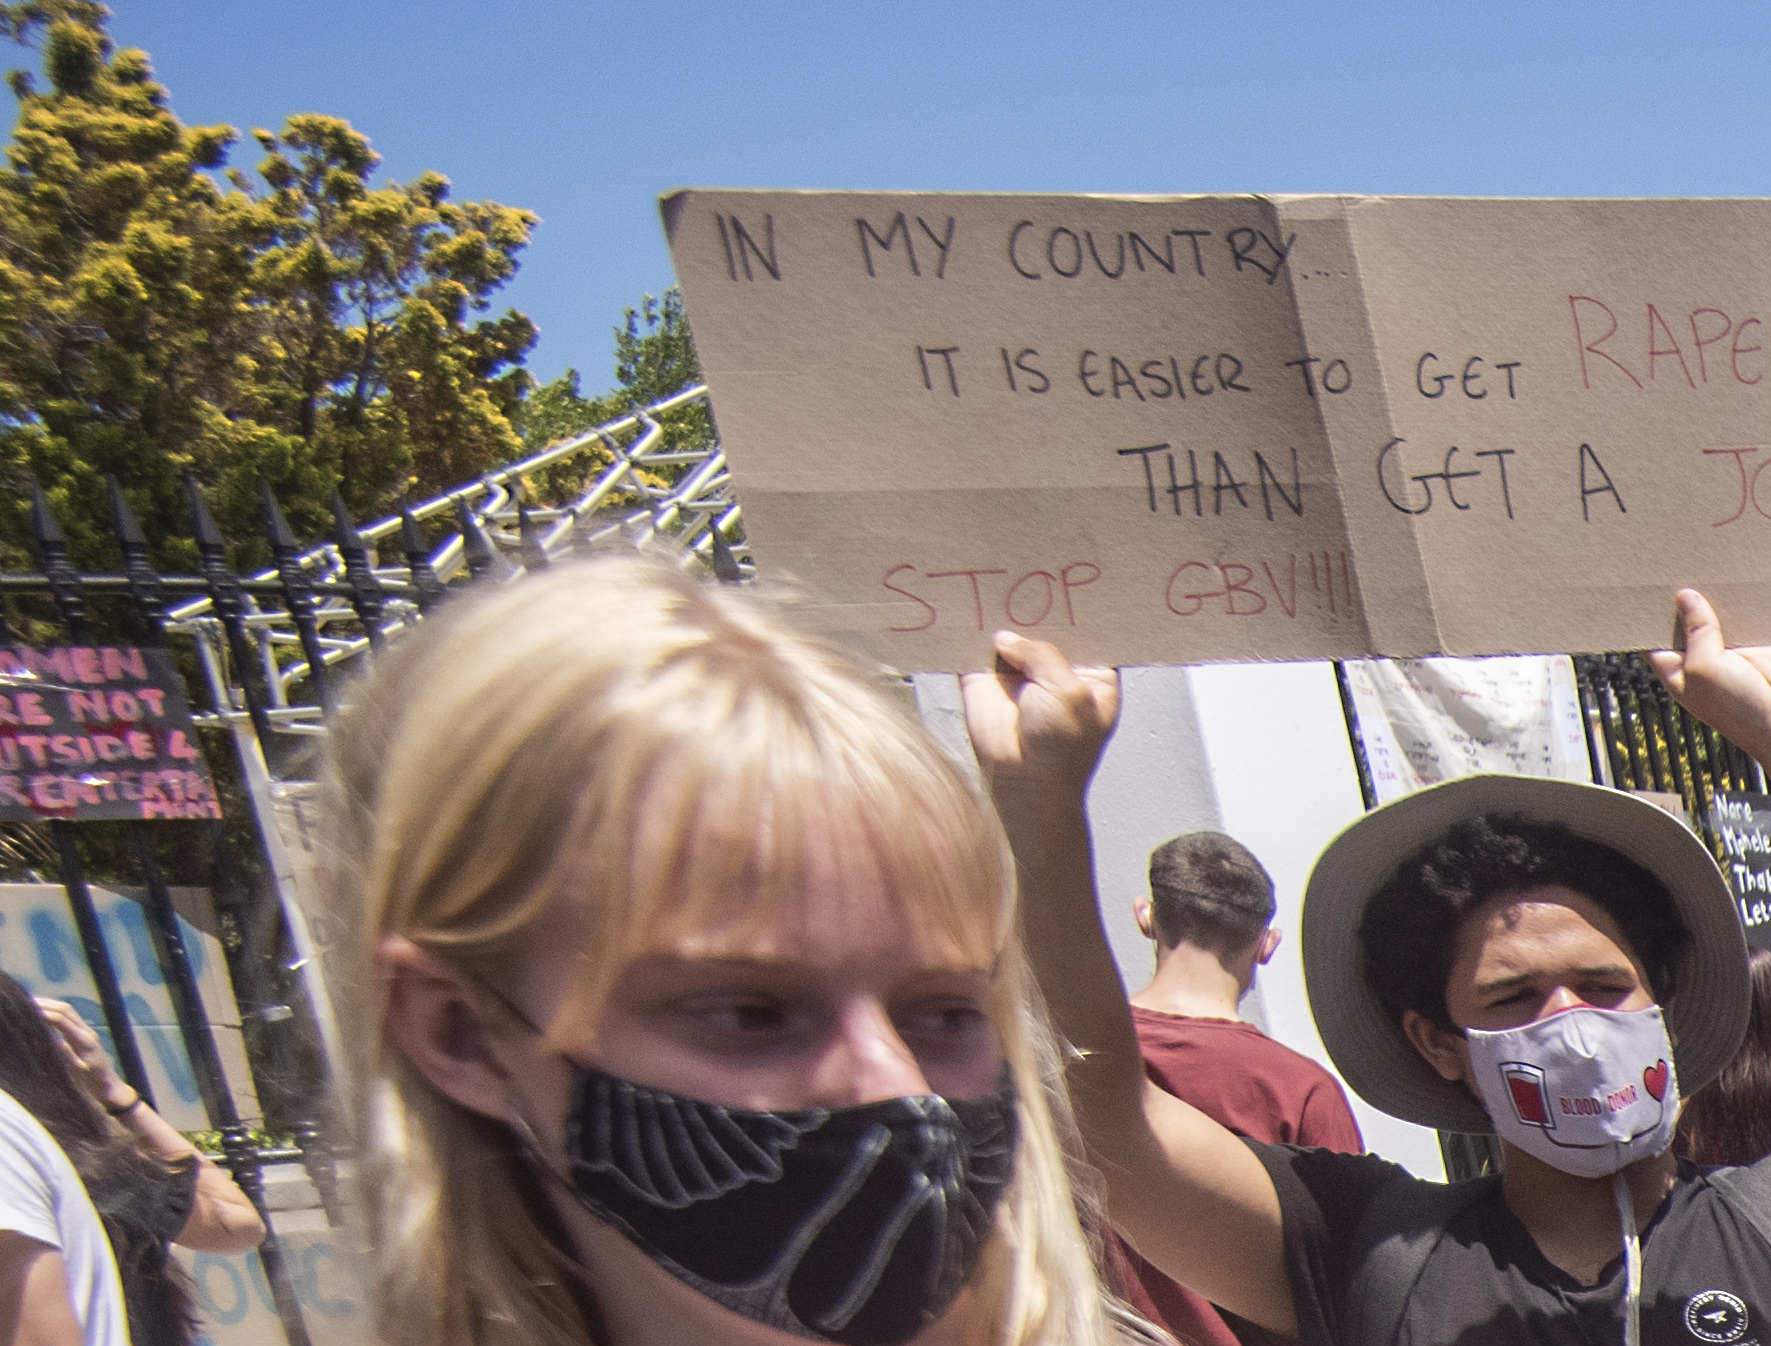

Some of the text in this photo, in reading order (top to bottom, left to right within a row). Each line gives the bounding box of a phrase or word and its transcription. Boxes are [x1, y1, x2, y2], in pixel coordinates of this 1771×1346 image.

[715, 212, 781, 282] IN
[855, 211, 956, 279] MY
[917, 345, 961, 397] IT
[1001, 347, 1052, 395] IS
[1080, 350, 1252, 402] EASIER
[1284, 357, 1353, 397] TO
[1416, 352, 1523, 400] GET
[1117, 442, 1304, 522] THAN
[1377, 436, 1517, 517] GET
[1578, 442, 1628, 523] A
[881, 560, 1101, 632] STOP
[67, 689, 166, 723] NOT
